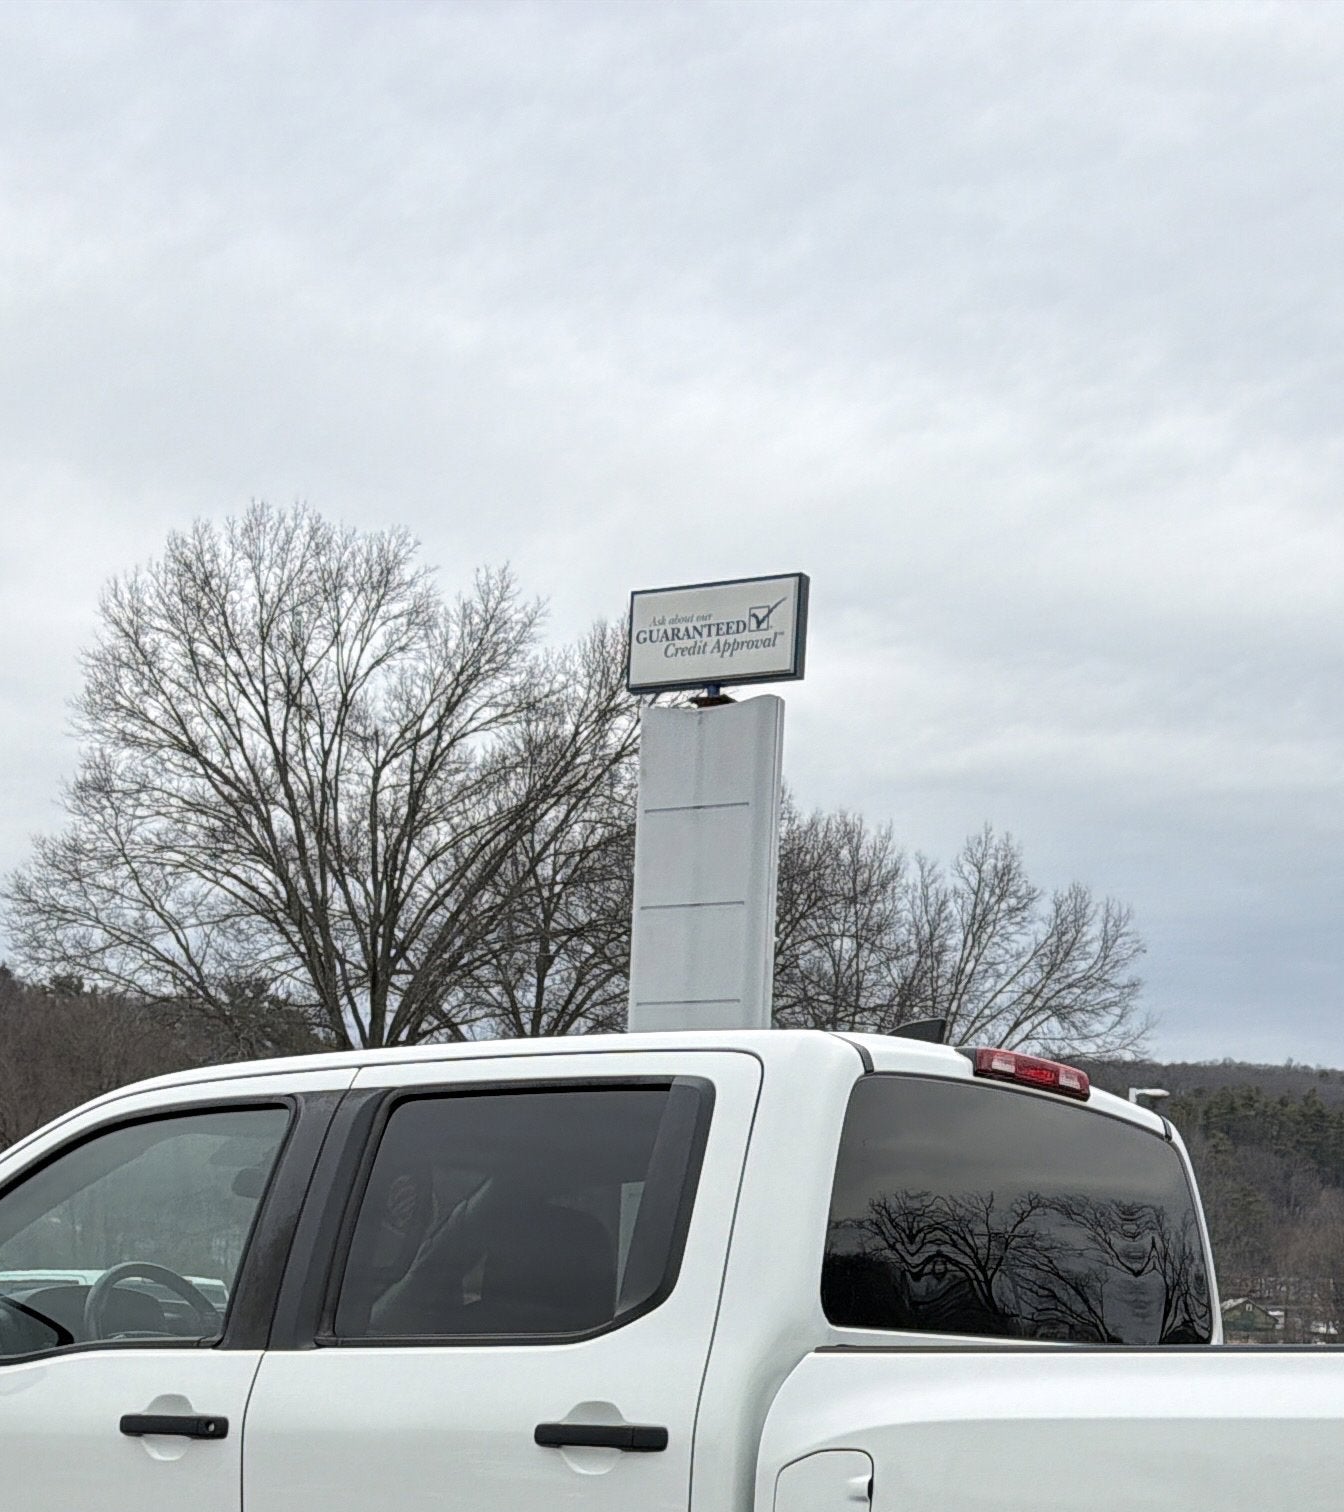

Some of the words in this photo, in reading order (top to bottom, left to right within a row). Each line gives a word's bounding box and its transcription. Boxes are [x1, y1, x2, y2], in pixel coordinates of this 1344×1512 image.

[668, 613, 695, 625] about
[696, 611, 713, 623] our
[636, 620, 747, 645] GUARANTEED
[663, 639, 707, 659] Credit
[710, 632, 778, 659] Approval
